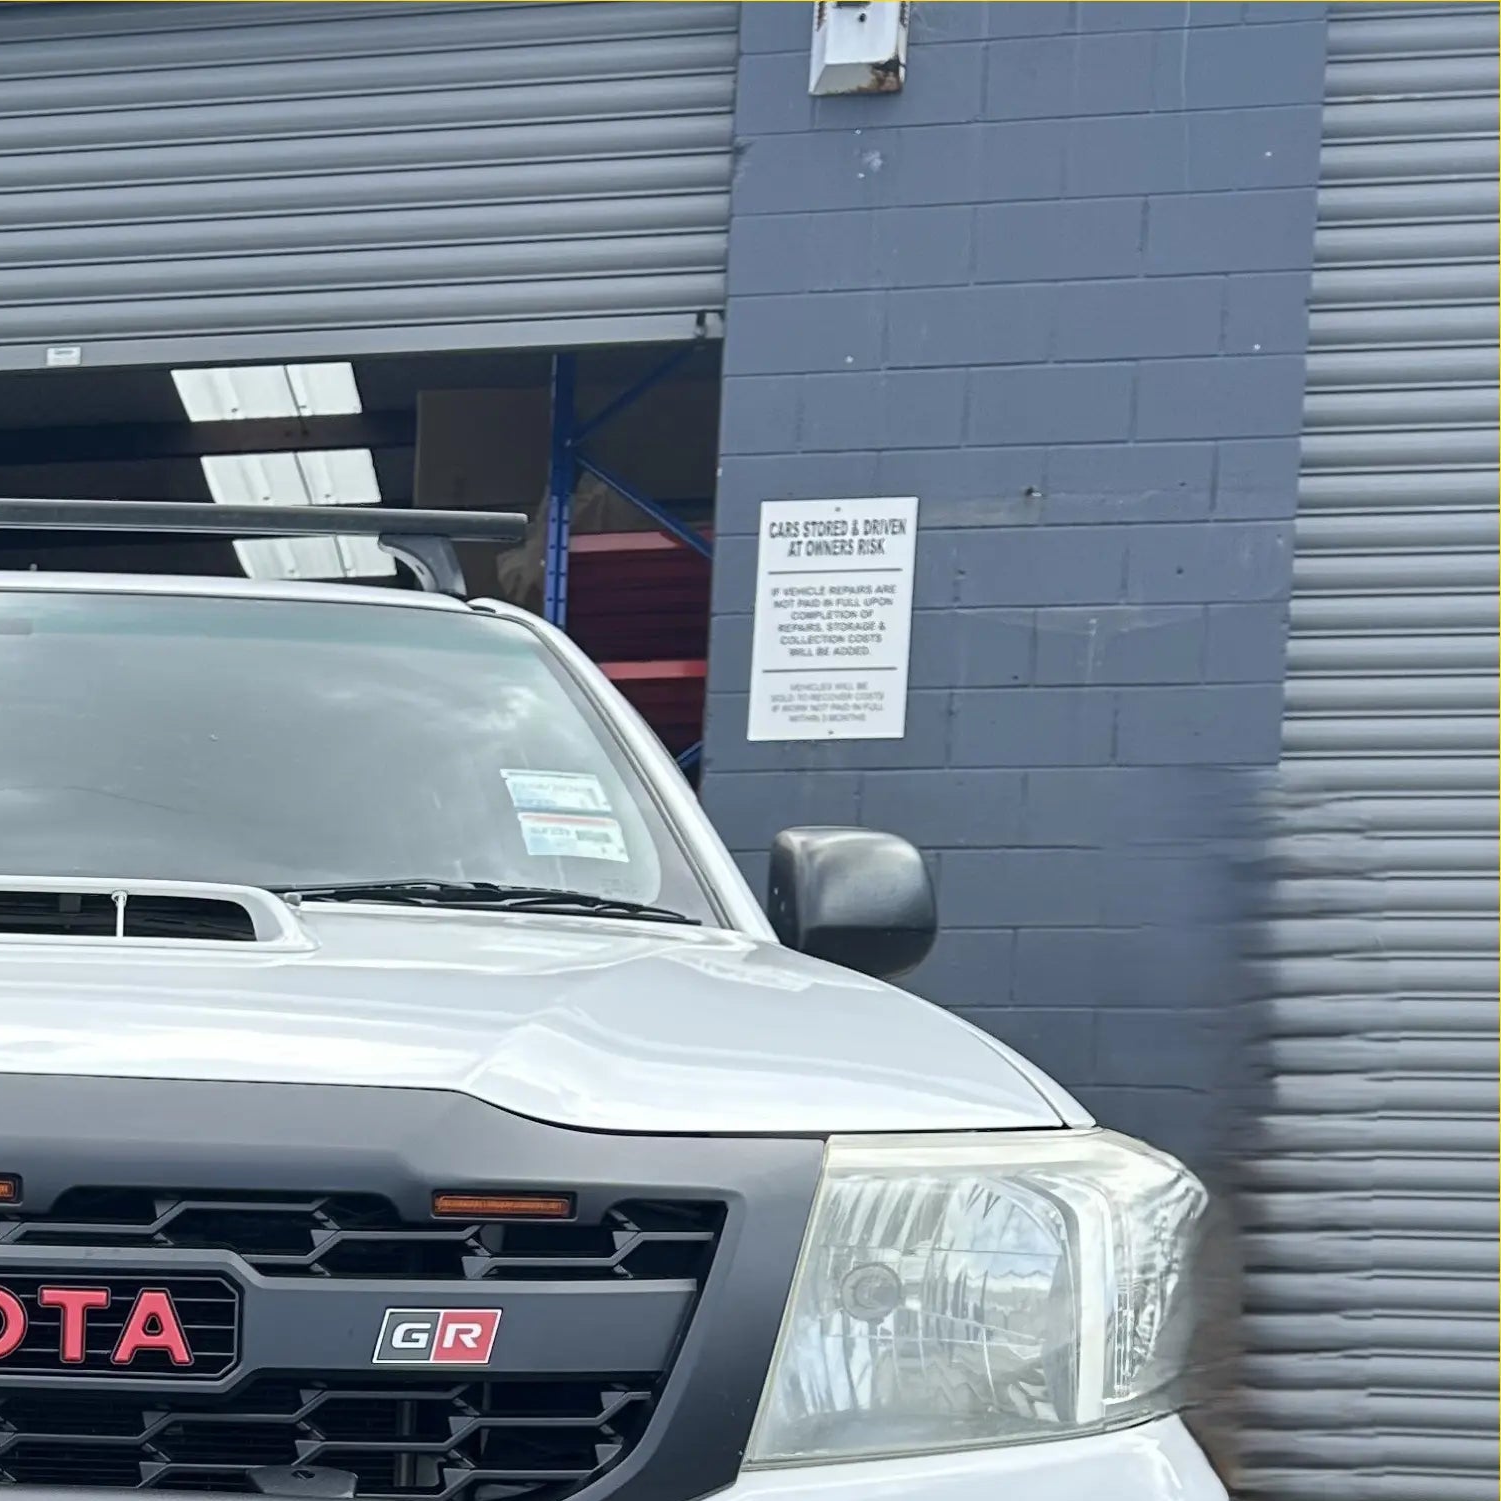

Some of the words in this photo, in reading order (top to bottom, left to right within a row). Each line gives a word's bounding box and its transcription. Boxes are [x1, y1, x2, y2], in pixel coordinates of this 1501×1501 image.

[769, 521, 800, 538] CARS
[803, 520, 848, 537] STORED
[851, 519, 860, 536] &
[863, 518, 907, 535] DRIVEN
[787, 540, 803, 557] AT
[806, 539, 853, 556] OWNERS
[856, 538, 885, 555] RISK
[783, 586, 826, 596] VEHICLE
[829, 585, 873, 594] REPAIRS
[874, 584, 897, 594] ARE
[773, 600, 795, 608] NOT
[797, 599, 820, 607] PAID
[835, 598, 860, 607] FULL
[863, 597, 893, 606] UPON
[791, 610, 857, 620] COMPLETION
[859, 609, 874, 618] OF
[826, 621, 875, 631] STORAGE
[779, 635, 845, 645] COLLECTION
[847, 634, 883, 643] COSTS
[789, 648, 813, 656] WILL
[816, 647, 829, 656] BE
[391, 1323, 483, 1349] GR
